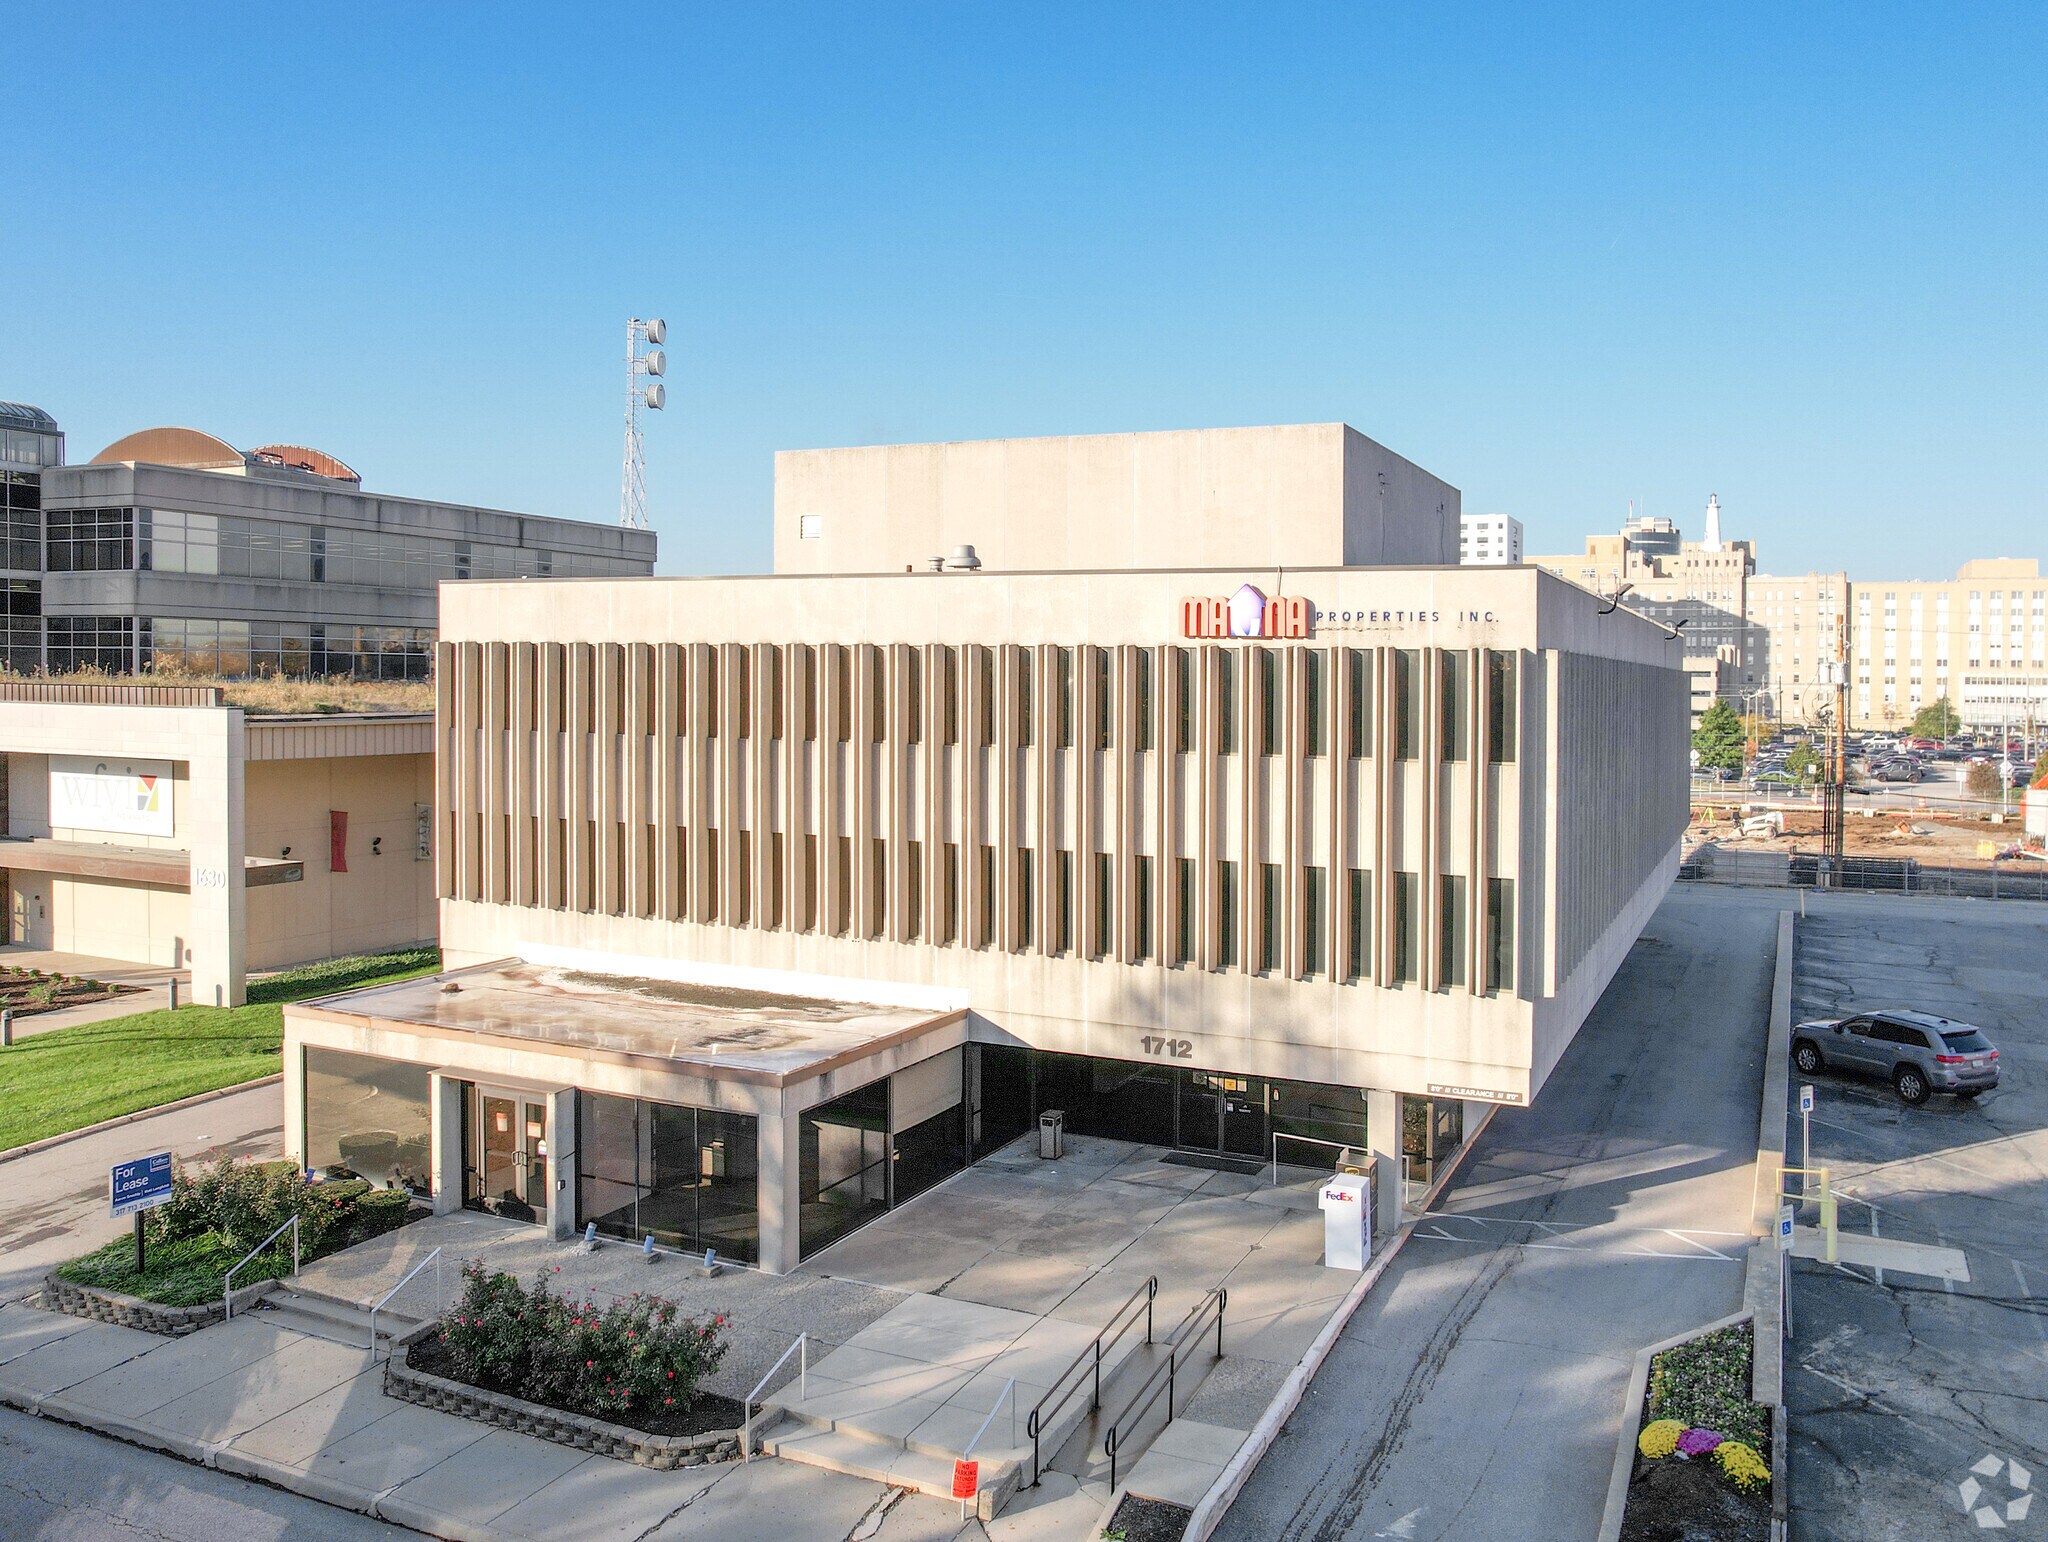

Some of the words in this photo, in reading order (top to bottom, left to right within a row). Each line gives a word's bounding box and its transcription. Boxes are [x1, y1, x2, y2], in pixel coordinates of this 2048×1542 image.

[1315, 611, 1440, 622] PROPERTIES
[1459, 611, 1500, 623] INC.
[195, 867, 227, 889] 1630
[1140, 1035, 1193, 1059] 1712
[1452, 1088, 1494, 1098] CLEARANCE
[115, 1167, 136, 1180] For
[115, 1176, 149, 1194] Lease
[1325, 1190, 1353, 1202] FedEx
[115, 1207, 126, 1216] 317
[127, 1204, 138, 1212] 713
[140, 1200, 154, 1209] 2100
